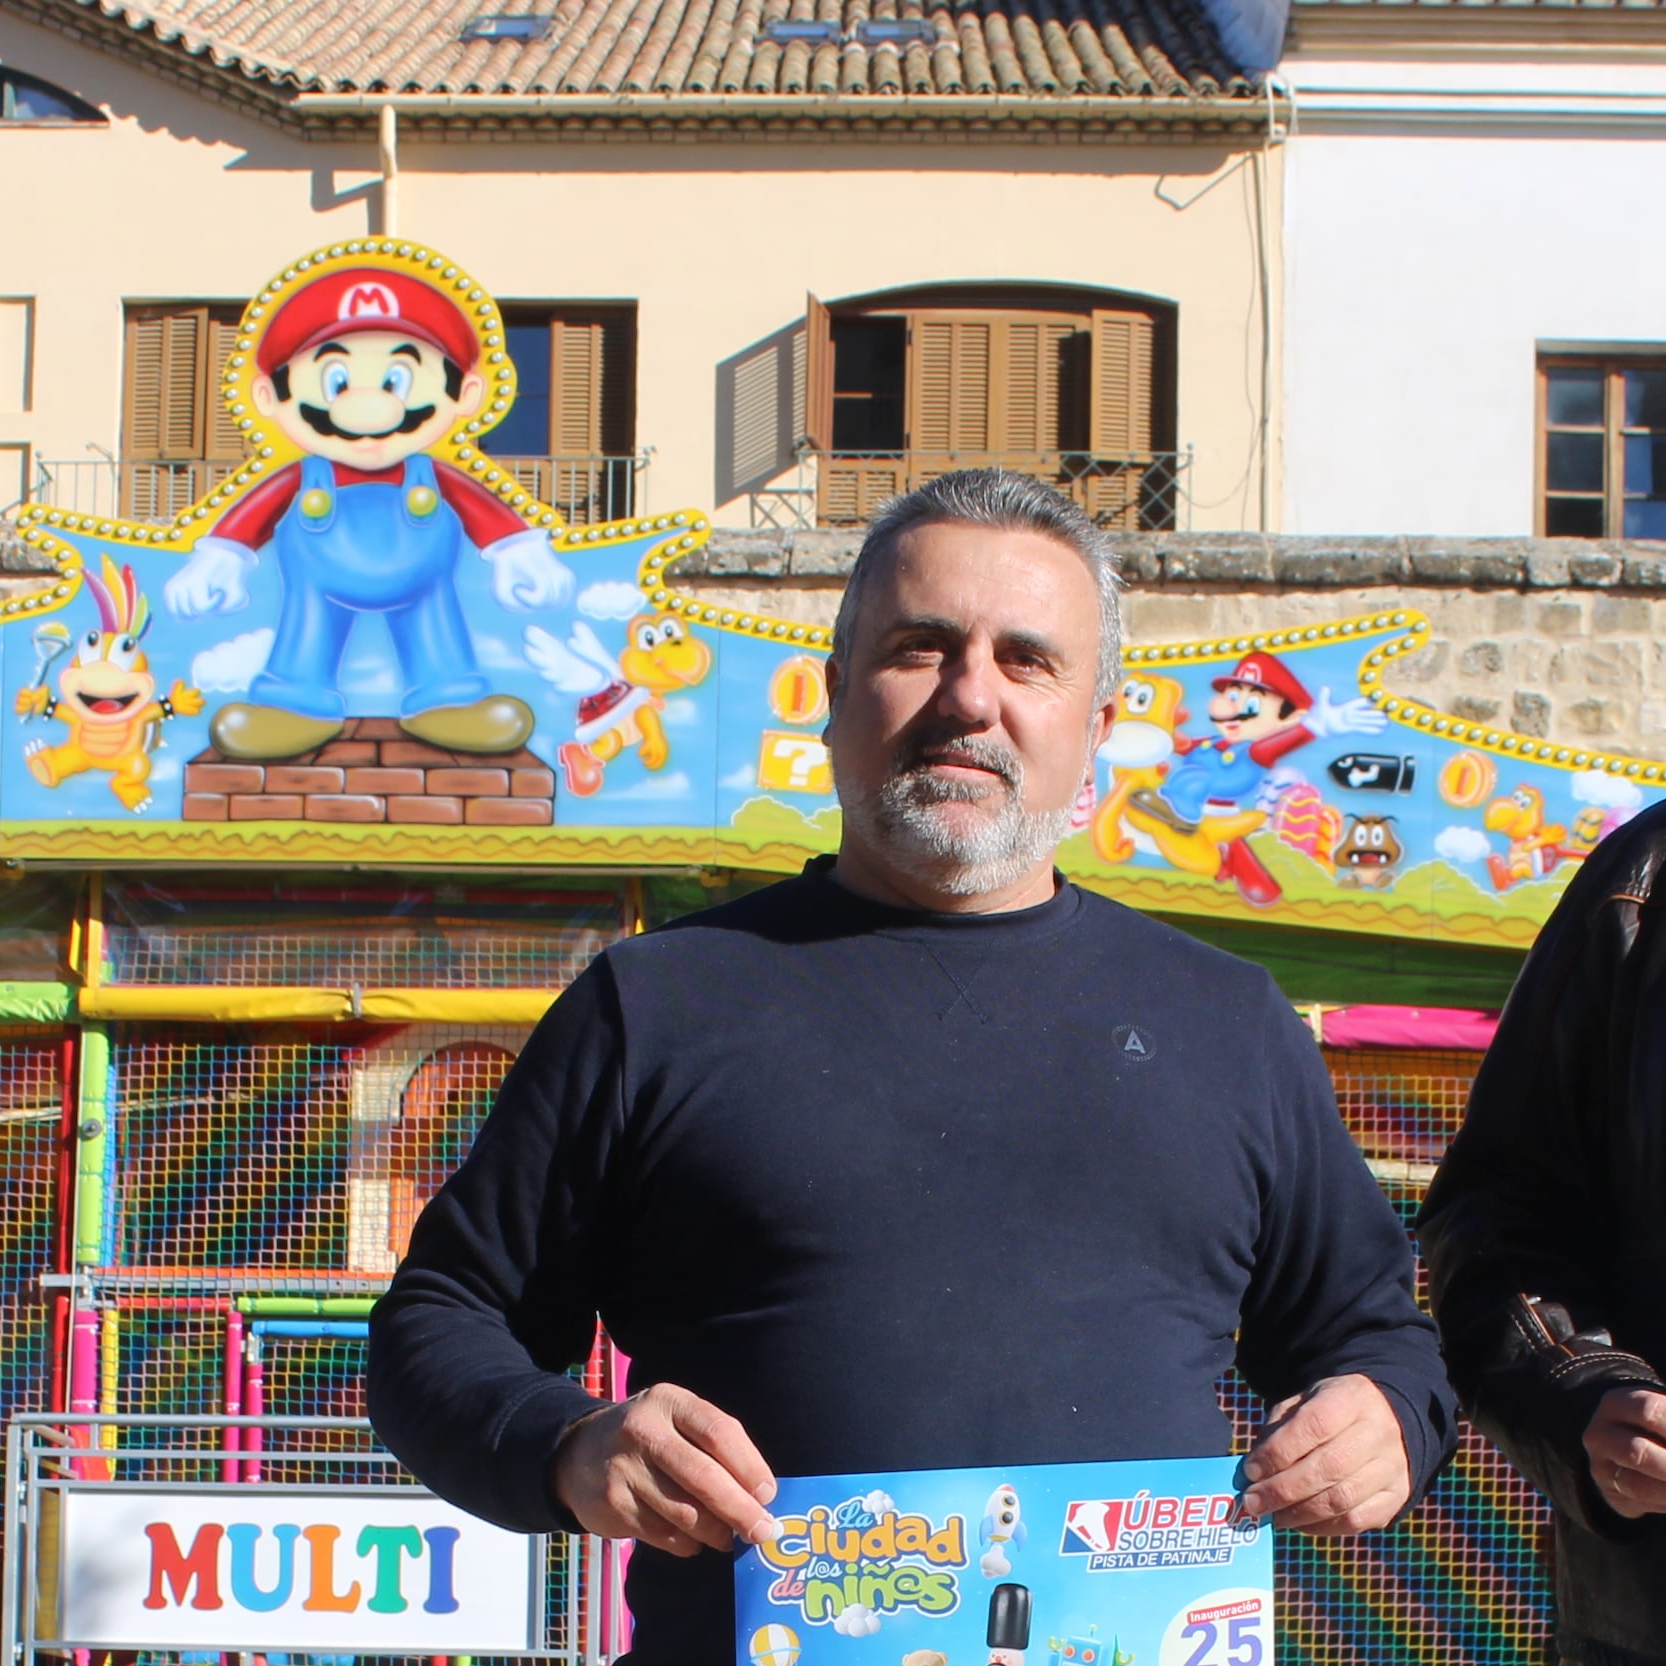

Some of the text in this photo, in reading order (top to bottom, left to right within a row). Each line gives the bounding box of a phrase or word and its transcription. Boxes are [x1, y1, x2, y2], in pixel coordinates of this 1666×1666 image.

[838, 1500, 873, 1528] La
[1123, 1491, 1259, 1530] ÚBEDA
[760, 1509, 964, 1568] Ciudad
[1118, 1524, 1258, 1551] SOBRE HIELO
[142, 1522, 461, 1614] MULTI
[807, 1556, 842, 1578] l@s
[1092, 1548, 1229, 1569] PISTA DE PATINAJE
[773, 1569, 805, 1597] de
[805, 1563, 954, 1618] niñ@s
[1190, 1600, 1259, 1623] Inauguración
